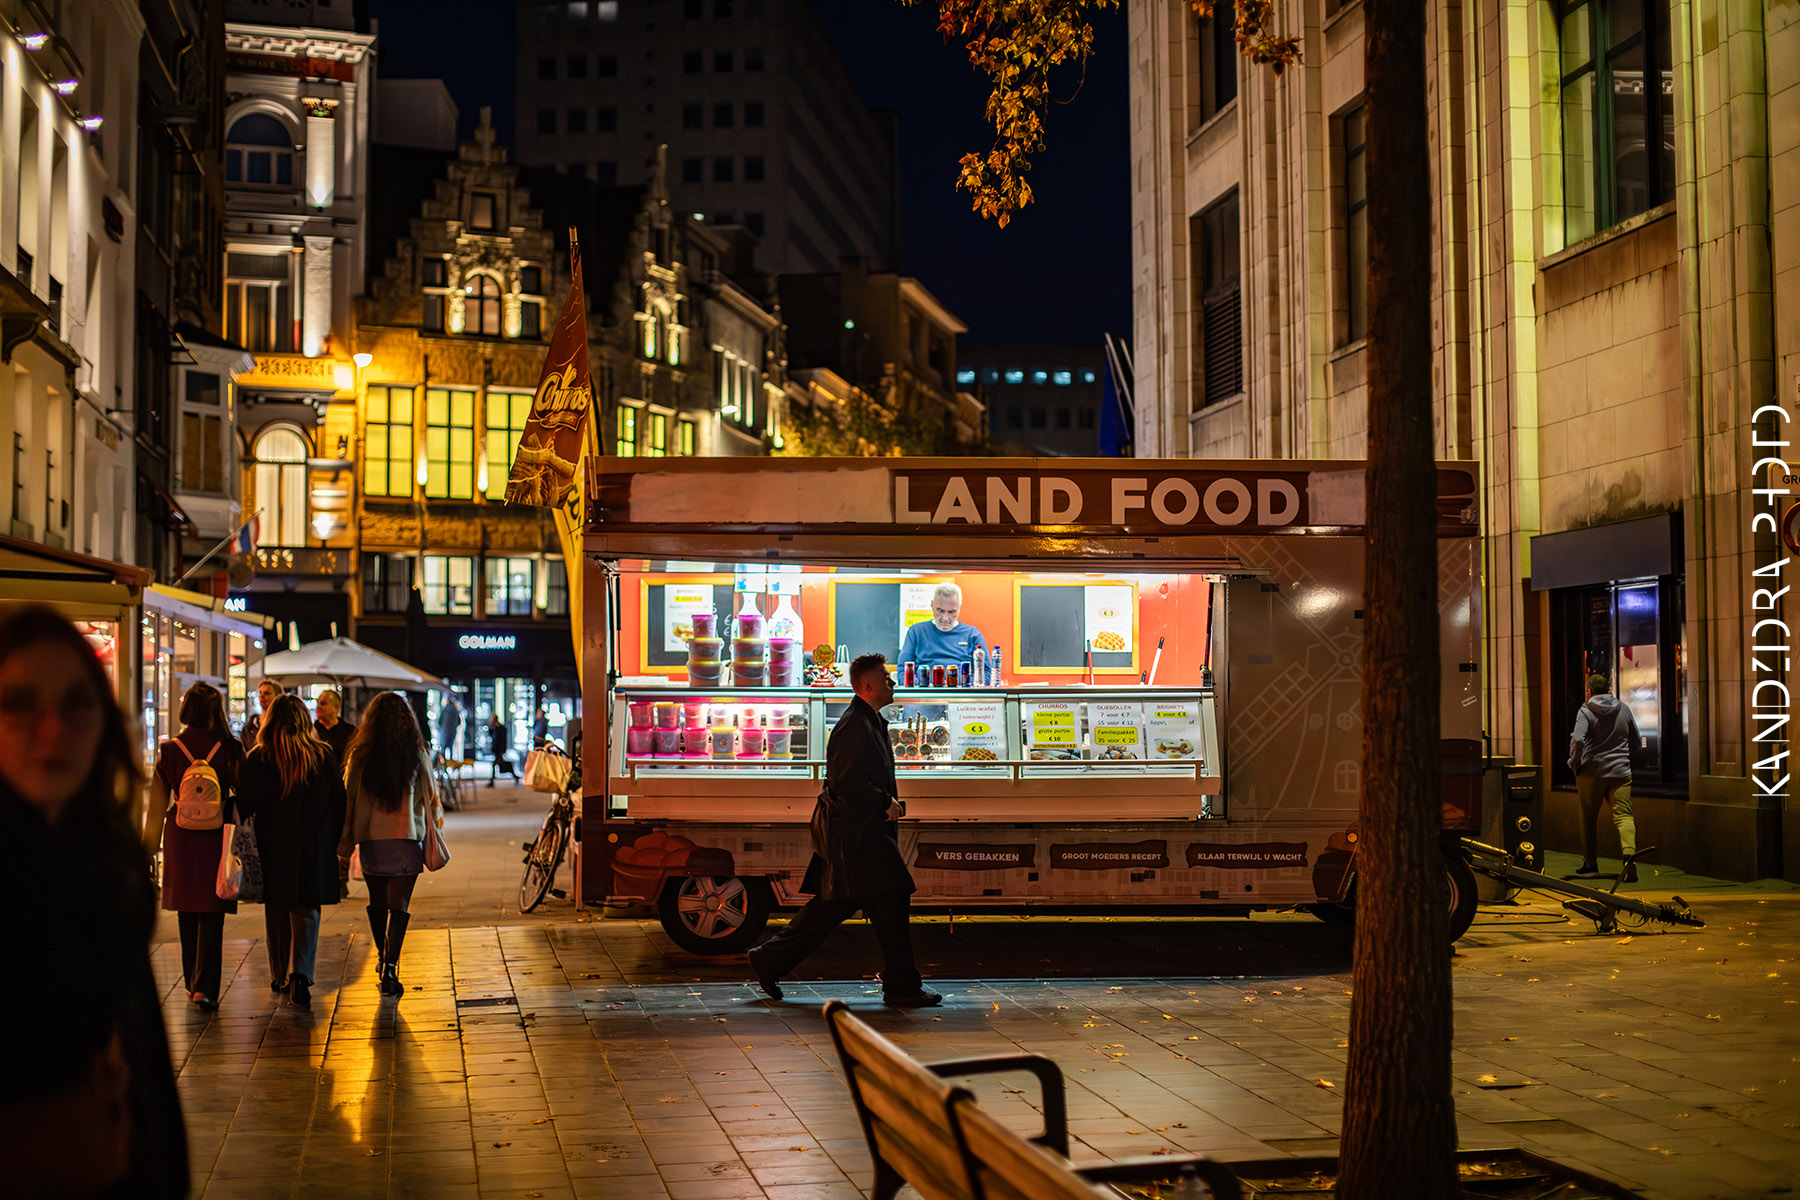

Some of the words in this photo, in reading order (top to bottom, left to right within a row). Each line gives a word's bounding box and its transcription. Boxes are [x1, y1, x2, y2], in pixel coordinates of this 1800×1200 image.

[1782, 474, 1800, 485] GR
[895, 476, 1083, 525] LAND
[1110, 477, 1300, 526] FOOD
[936, 852, 962, 860] VERS
[964, 852, 1019, 862] GEBAKKEN
